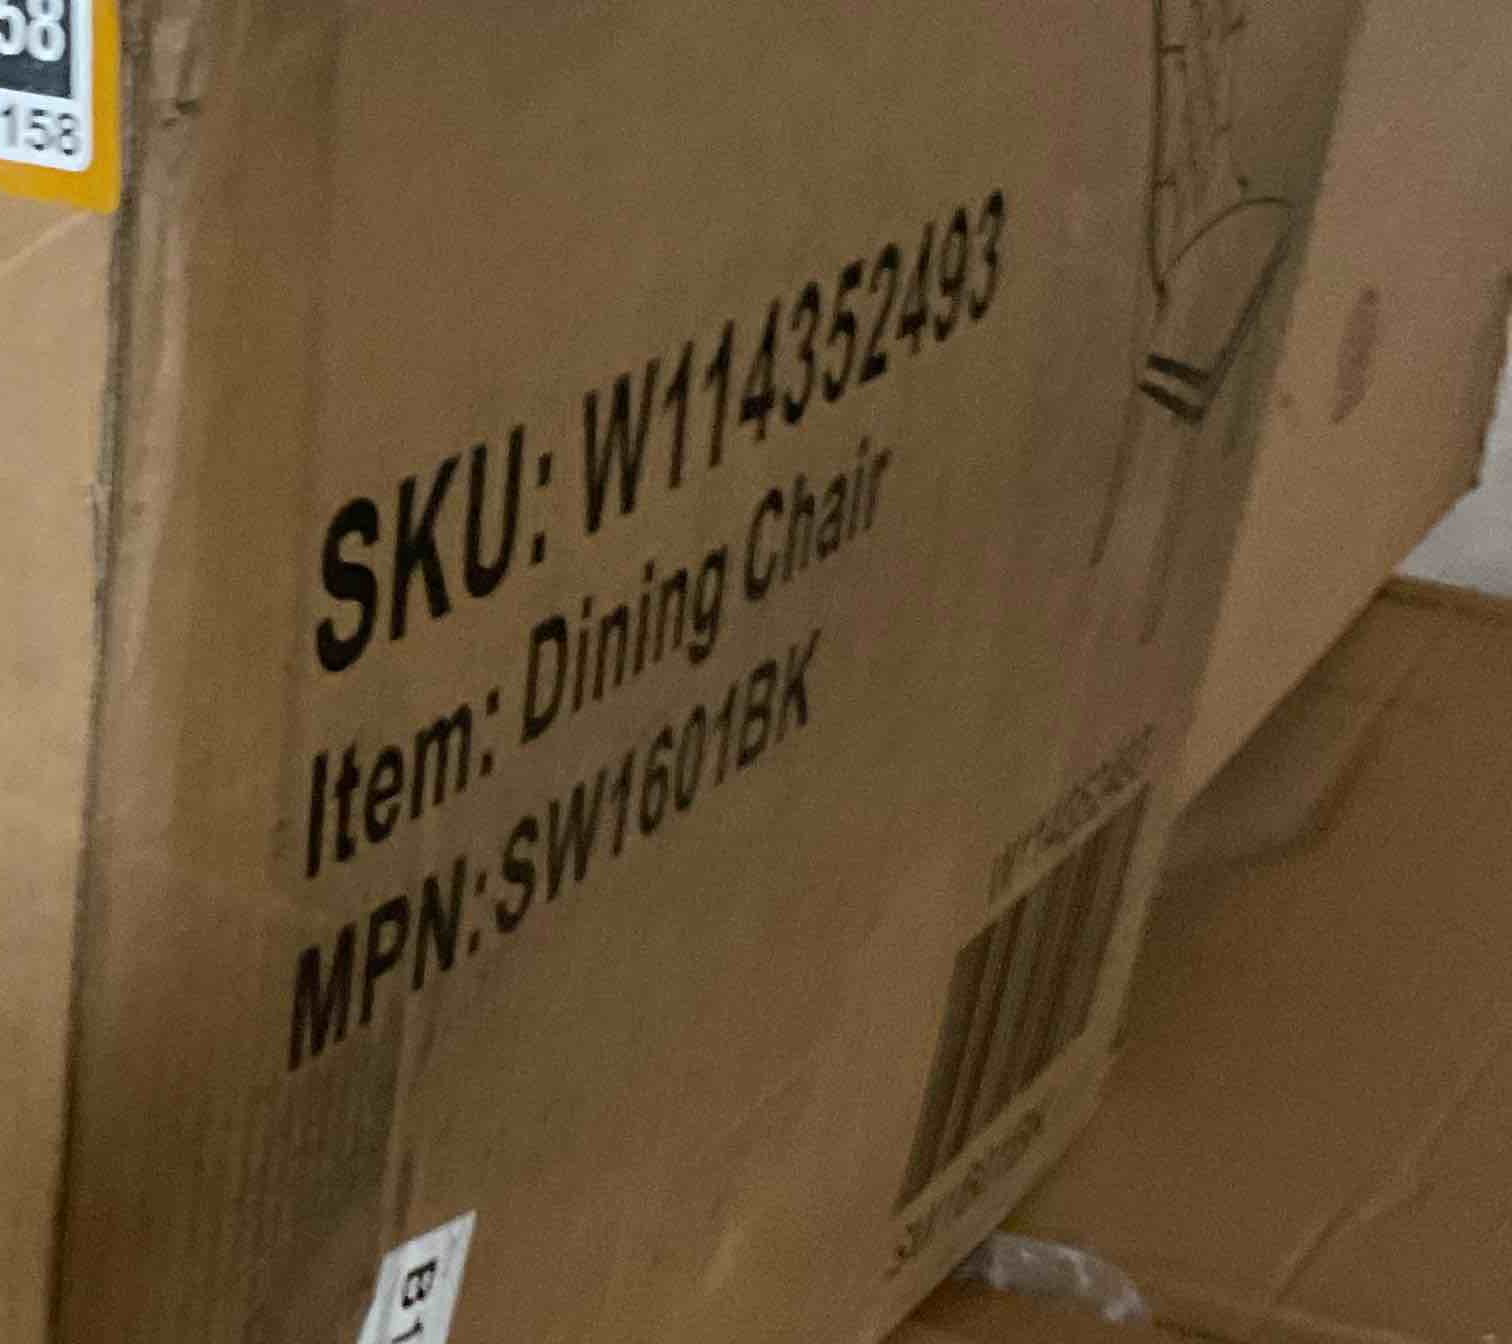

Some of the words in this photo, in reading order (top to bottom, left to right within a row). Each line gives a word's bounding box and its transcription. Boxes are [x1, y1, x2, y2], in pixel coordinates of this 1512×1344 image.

[304, 684, 501, 879] Item:
[520, 543, 728, 746] Dining
[743, 436, 894, 604] Chair
[314, 422, 554, 674] SKU:
[583, 187, 1005, 537] W114352493
